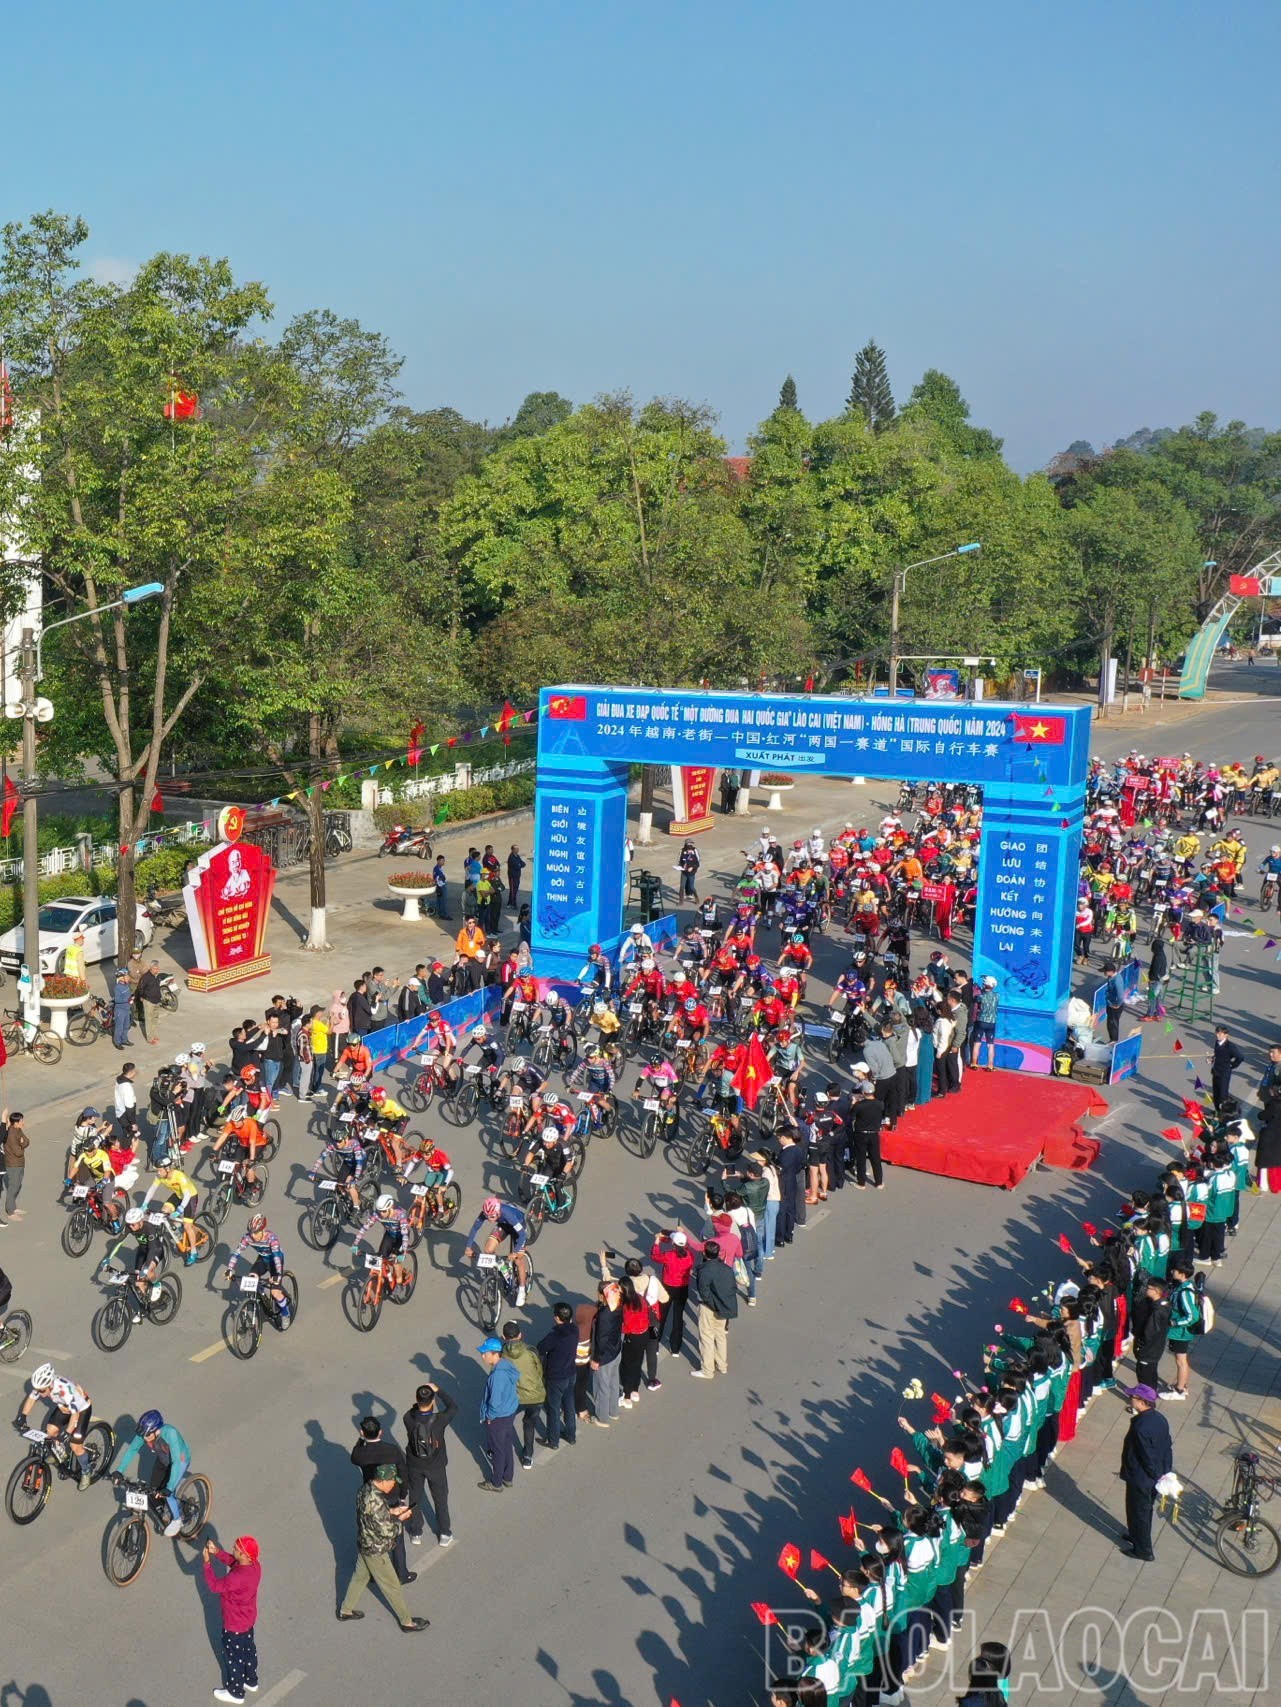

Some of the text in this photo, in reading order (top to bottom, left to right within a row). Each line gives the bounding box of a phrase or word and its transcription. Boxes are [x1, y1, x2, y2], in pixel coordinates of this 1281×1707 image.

[626, 704, 635, 719] XE
[808, 713, 821, 729] CAI
[985, 720, 1006, 737] 2024
[745, 749, 769, 760] XUẤT
[771, 751, 795, 761] PHÁT
[551, 804, 569, 814] BIÊN
[1000, 841, 1026, 852] GIAO
[1002, 857, 1022, 868] LƯU
[996, 873, 1026, 886] ĐOÀN
[1000, 890, 1019, 902] KẾT
[990, 906, 1027, 919] HƯỚNG
[990, 923, 1025, 936] TƯƠNG
[999, 941, 1014, 952] LAI
